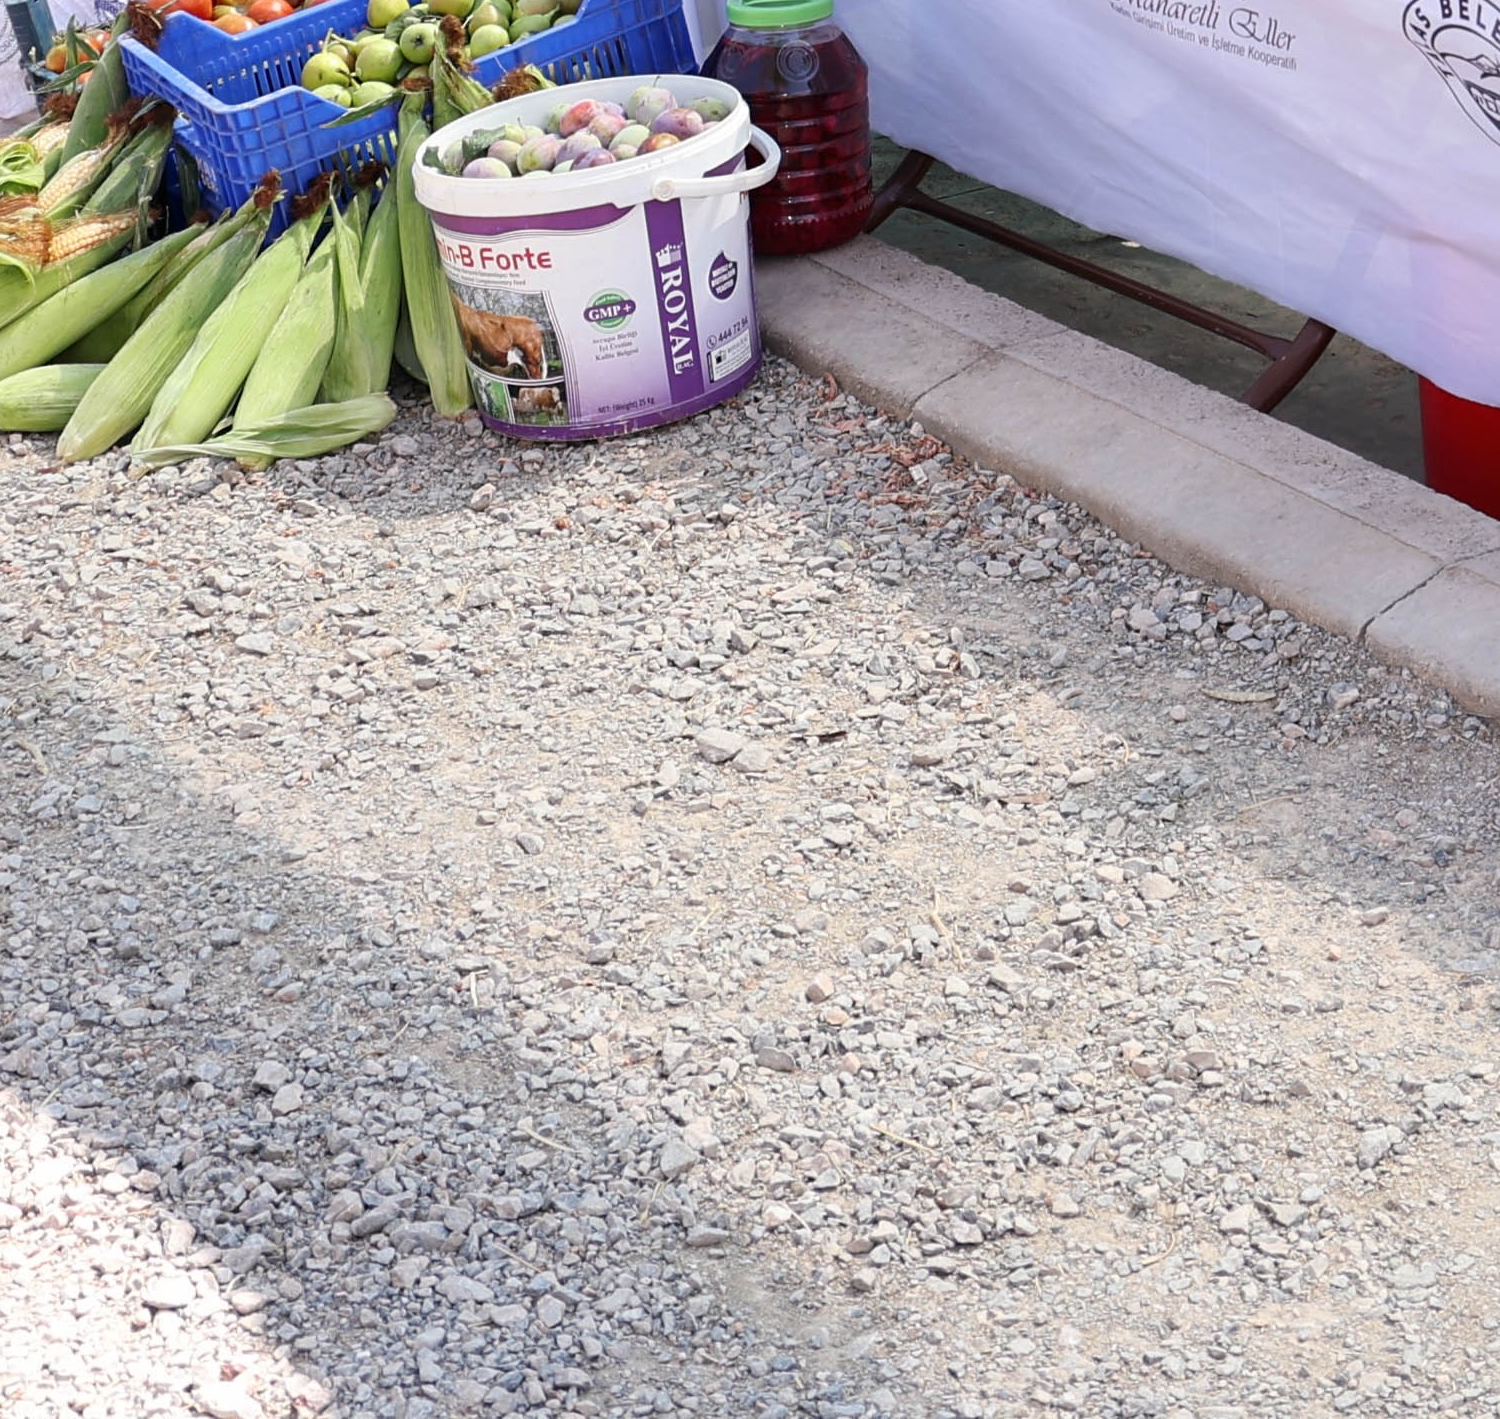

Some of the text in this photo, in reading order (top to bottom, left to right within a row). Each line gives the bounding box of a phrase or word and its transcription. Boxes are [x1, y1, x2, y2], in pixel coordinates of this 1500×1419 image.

[1229, 7, 1297, 52] Eller
[479, 246, 553, 271] Forte
[661, 265, 695, 376] ROYAL
